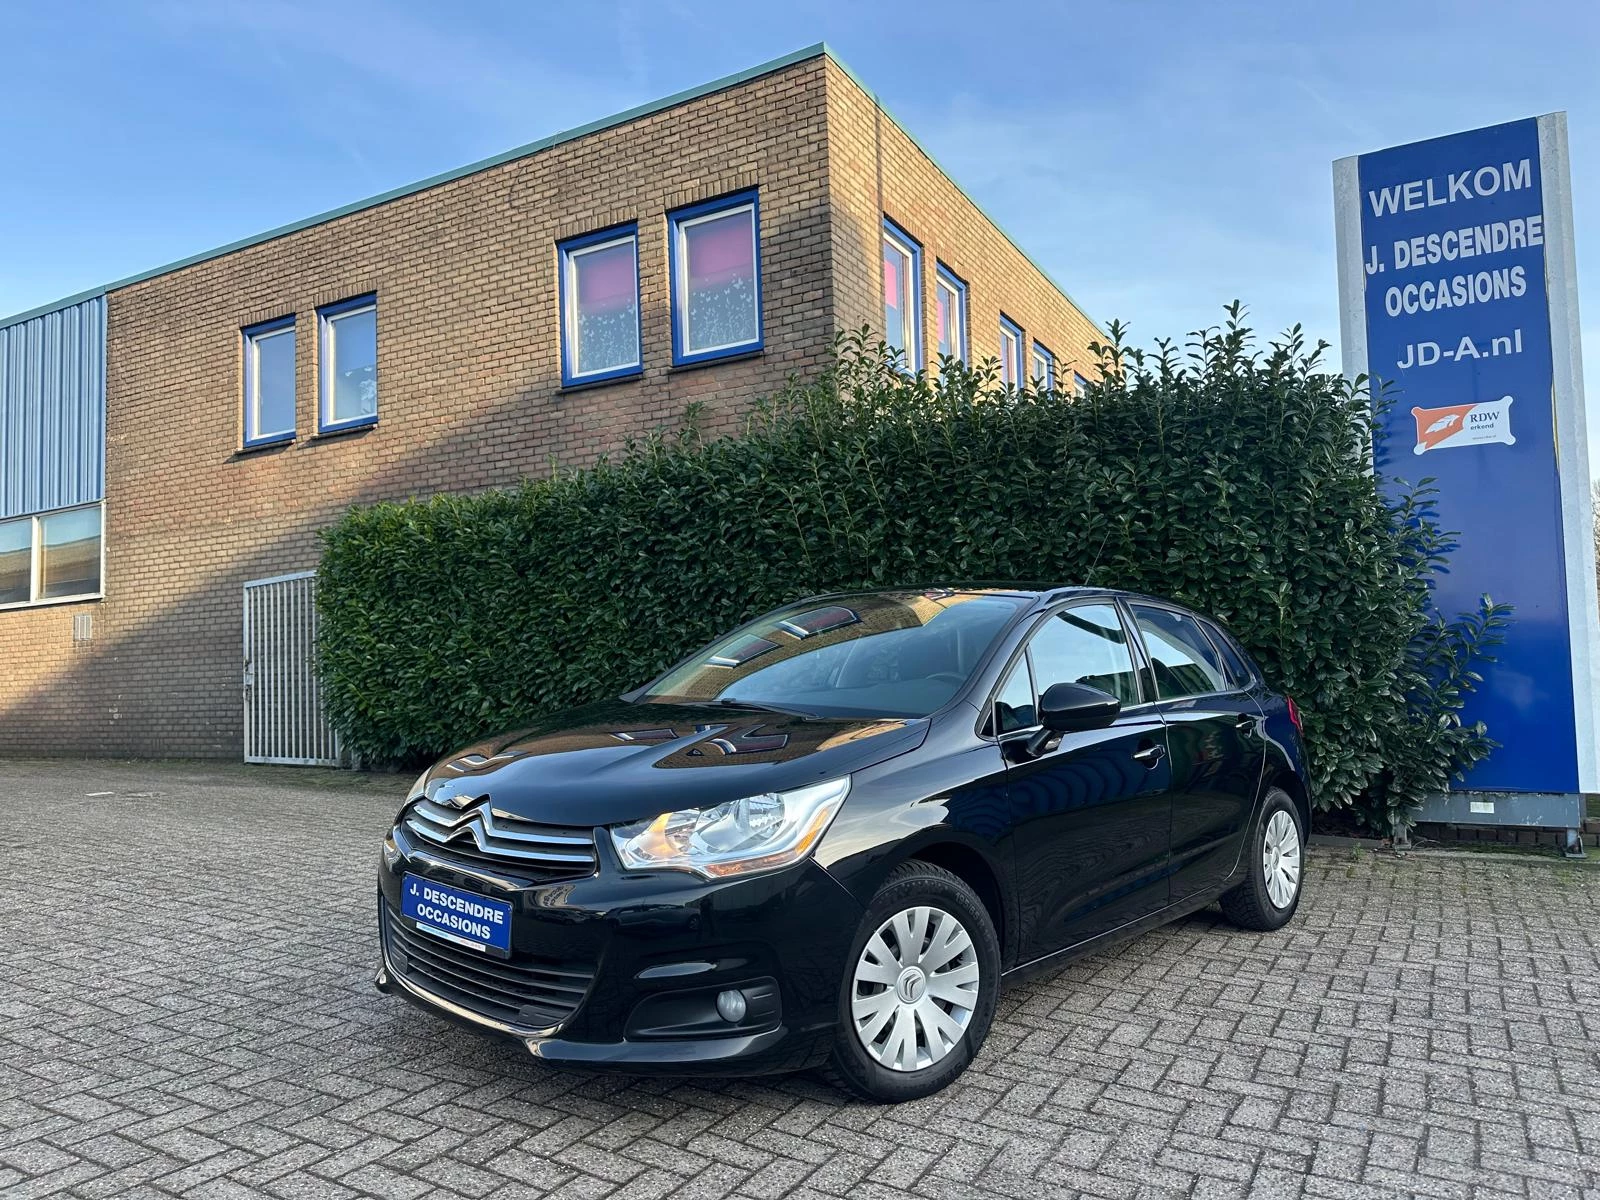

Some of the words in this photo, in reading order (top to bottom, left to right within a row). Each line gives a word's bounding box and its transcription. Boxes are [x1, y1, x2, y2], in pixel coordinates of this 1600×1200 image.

[1368, 158, 1532, 217] WELKOM
[1365, 245, 1385, 275] J.
[1395, 215, 1544, 270] DESCENDRE
[1385, 265, 1527, 317] OCCASIONS
[1396, 328, 1522, 369] JD-A.nl
[1470, 411, 1500, 423] RDW
[410, 883, 419, 896] J.
[423, 887, 504, 925] DESCENDRE
[417, 903, 491, 939] OCCASIONS
